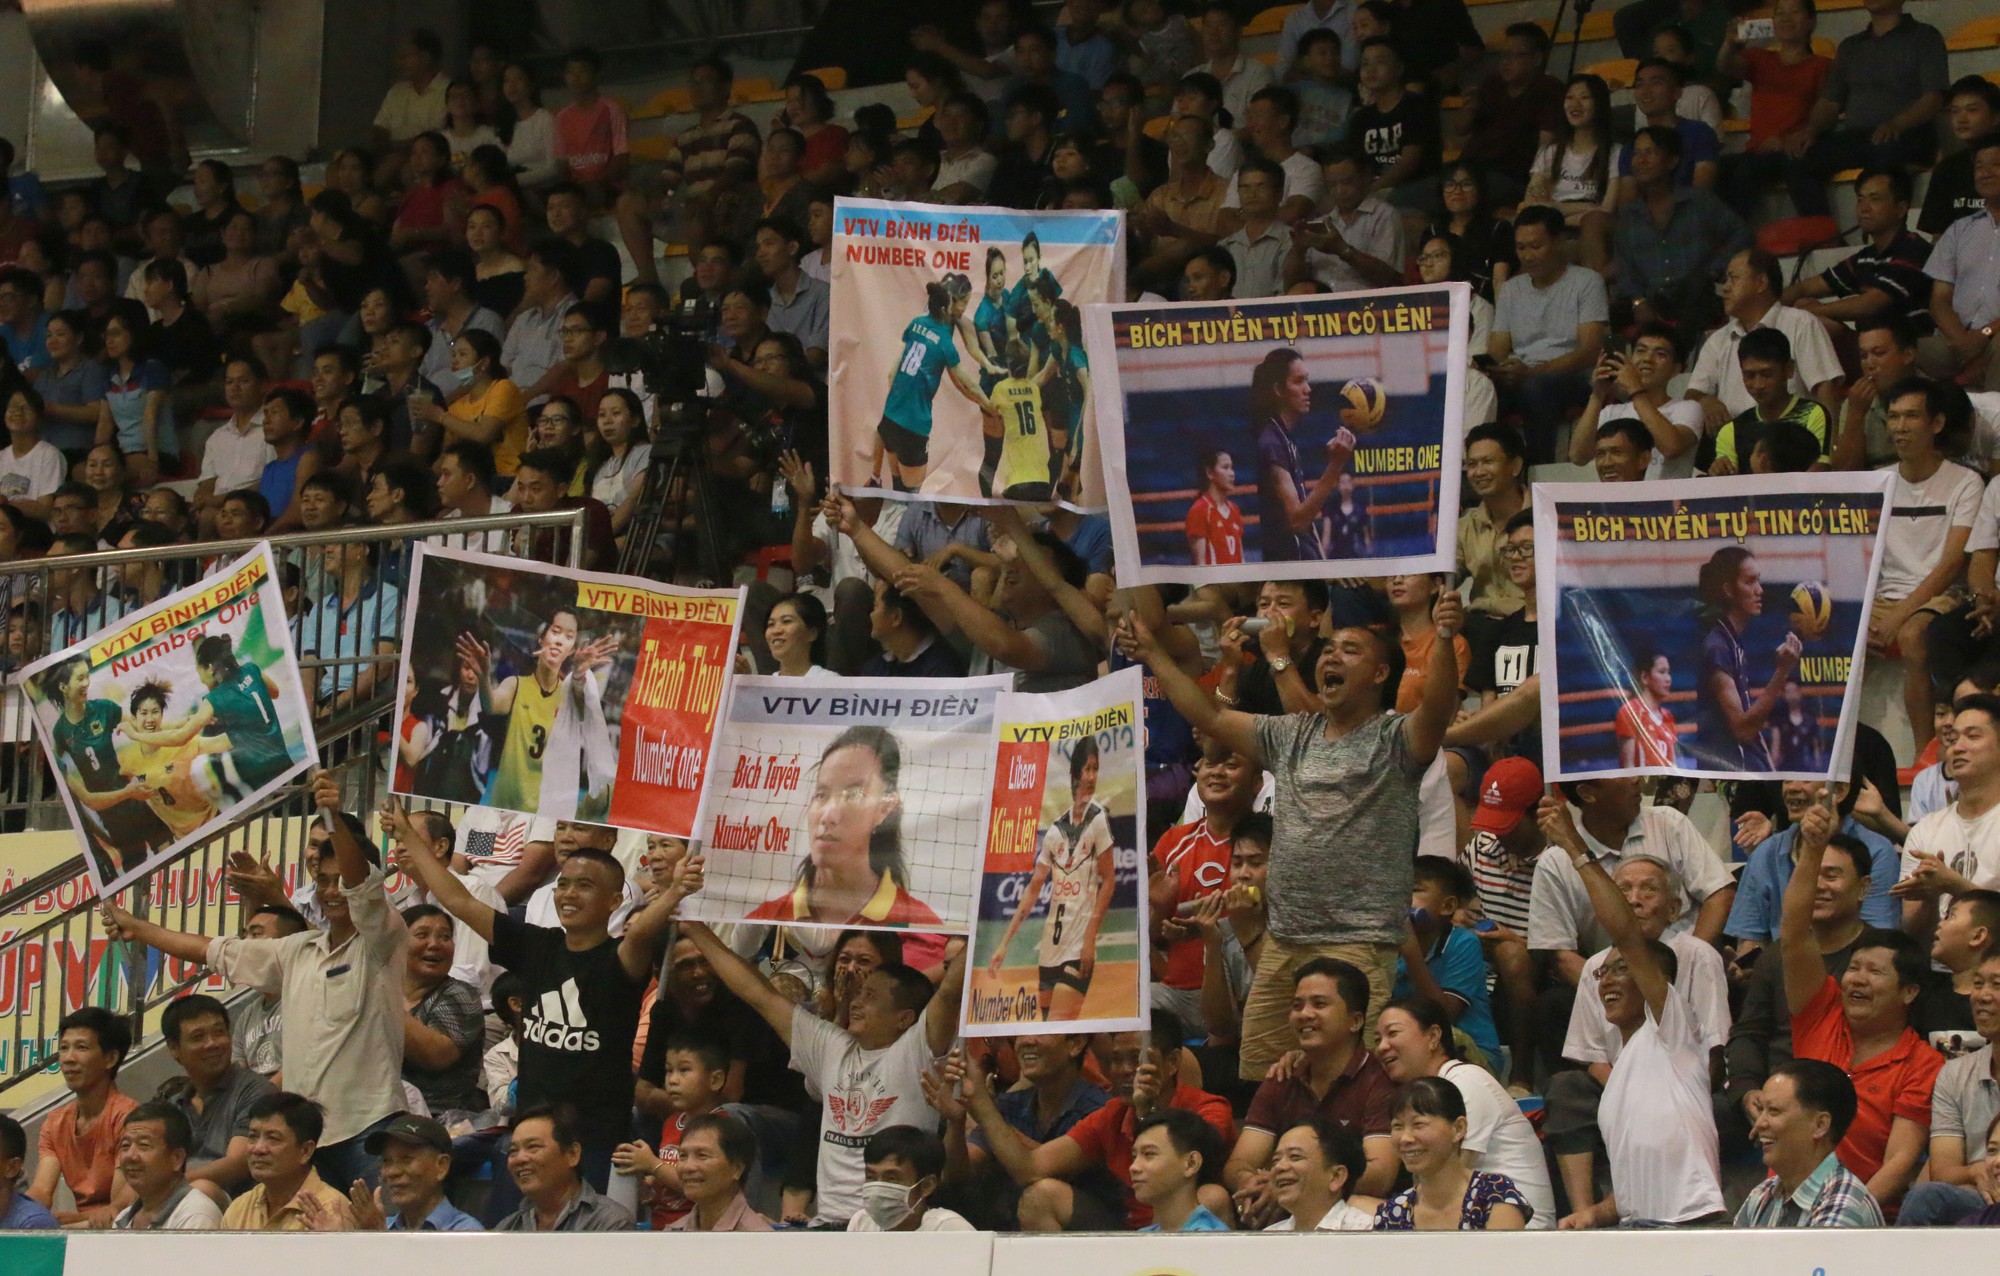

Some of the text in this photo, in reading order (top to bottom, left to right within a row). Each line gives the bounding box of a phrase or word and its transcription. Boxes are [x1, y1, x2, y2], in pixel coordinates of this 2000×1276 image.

[844, 218, 879, 237] VTV
[885, 216, 931, 241] BÌNH
[846, 244, 970, 271] NUMBER ONE
[1130, 302, 1432, 348] BÍCH TUYỀN TỰ TIN CỐ LÊN!
[901, 341, 927, 376] 18
[1014, 401, 1036, 436] 16
[1354, 444, 1440, 473] NUMBER ONE
[1573, 500, 1869, 544] BÍCH TUYỀN TỰ TIN CỐ LÊN!
[587, 588, 627, 612] VTV
[631, 592, 678, 619] BÌNH
[101, 626, 143, 658] VTV
[150, 597, 209, 635] BÌNH
[111, 591, 260, 678] Number One
[635, 639, 686, 710] Thanh
[1800, 656, 1852, 683] NUMBE
[762, 696, 822, 715] VTV
[829, 693, 901, 717] BÌNH
[529, 724, 546, 760] 3
[1013, 726, 1054, 743] VTV
[632, 725, 702, 791] Number one
[732, 754, 762, 789] Bích
[1008, 755, 1036, 790] Libero
[711, 814, 790, 852] Number One
[990, 806, 1037, 854] Kim Liên
[1052, 903, 1066, 945] 6
[970, 986, 1037, 1023] Number One
[523, 1017, 600, 1051] adidas
